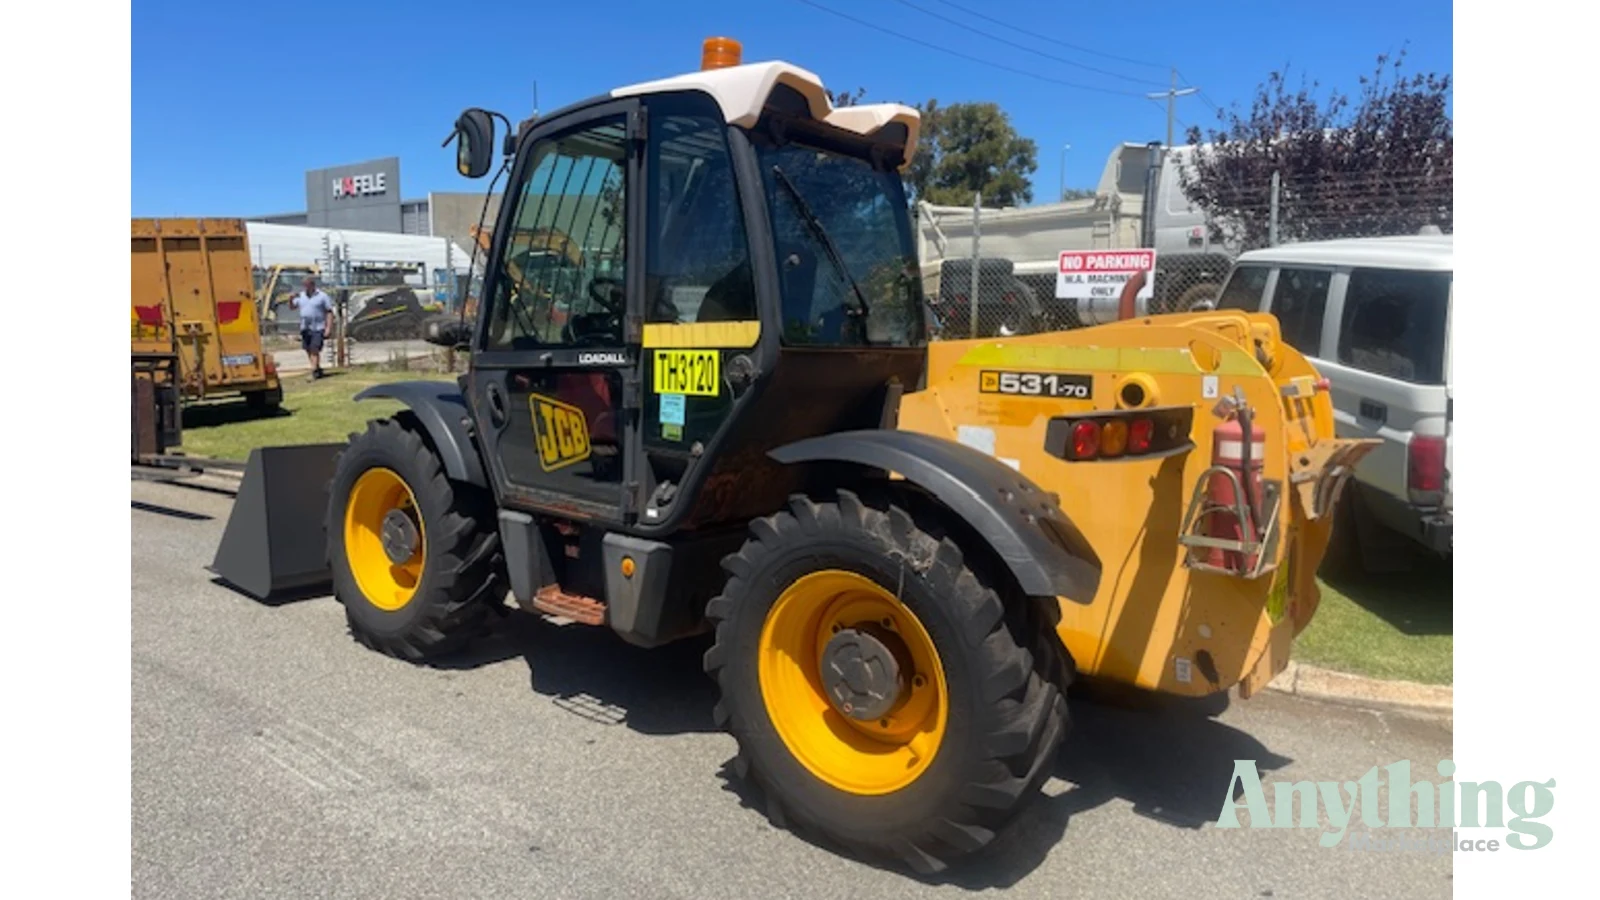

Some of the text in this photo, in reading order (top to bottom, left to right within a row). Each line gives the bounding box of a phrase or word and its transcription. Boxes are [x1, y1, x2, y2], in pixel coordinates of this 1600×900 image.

[1062, 254, 1150, 270] NO PARKING
[1091, 286, 1115, 296] ONLY
[578, 353, 625, 363] LOADALL
[659, 353, 714, 392] TH3120
[540, 402, 586, 463] JCB
